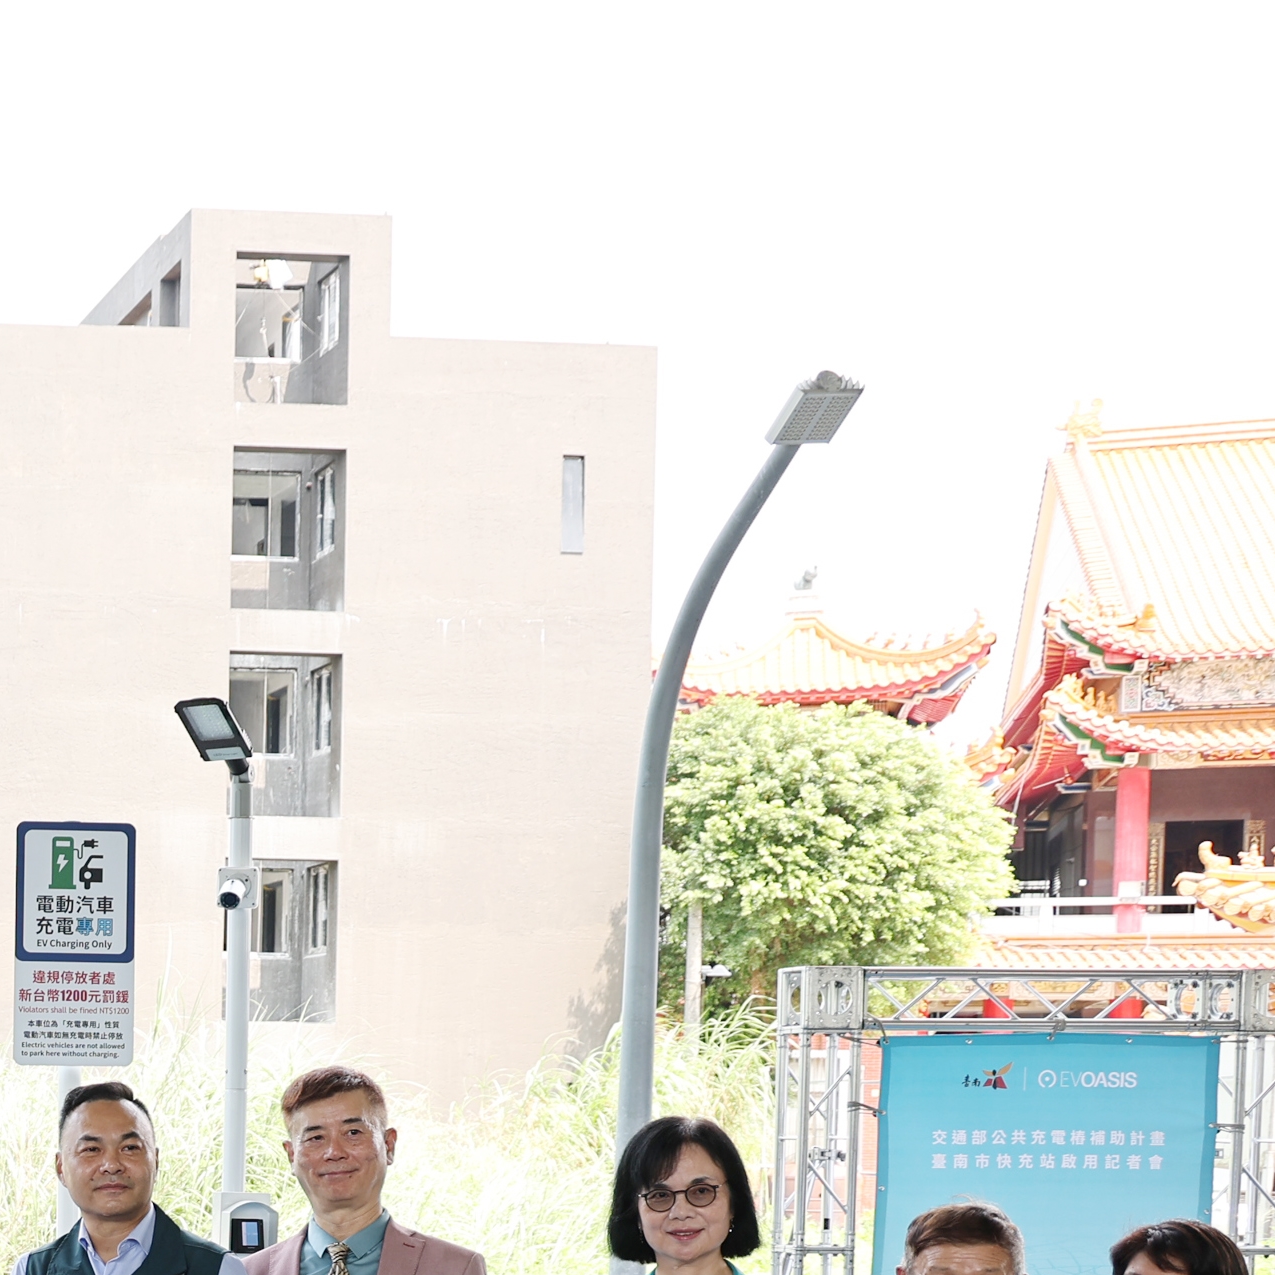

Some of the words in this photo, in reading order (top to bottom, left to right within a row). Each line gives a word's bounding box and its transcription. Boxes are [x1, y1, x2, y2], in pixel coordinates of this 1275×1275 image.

[35, 895, 114, 915] 電動汽車
[35, 916, 114, 937] 充電專用
[36, 939, 48, 947] EV
[49, 939, 90, 950] Charging
[91, 940, 113, 950] Only
[32, 970, 116, 985] 違規停放者處
[18, 1006, 49, 1014] Violators
[50, 1006, 67, 1014] shall
[69, 1006, 78, 1014] be
[99, 1007, 130, 1015] NT$1200
[29, 1050, 44, 1058] park
[1060, 1071, 1138, 1088] EVOASIS
